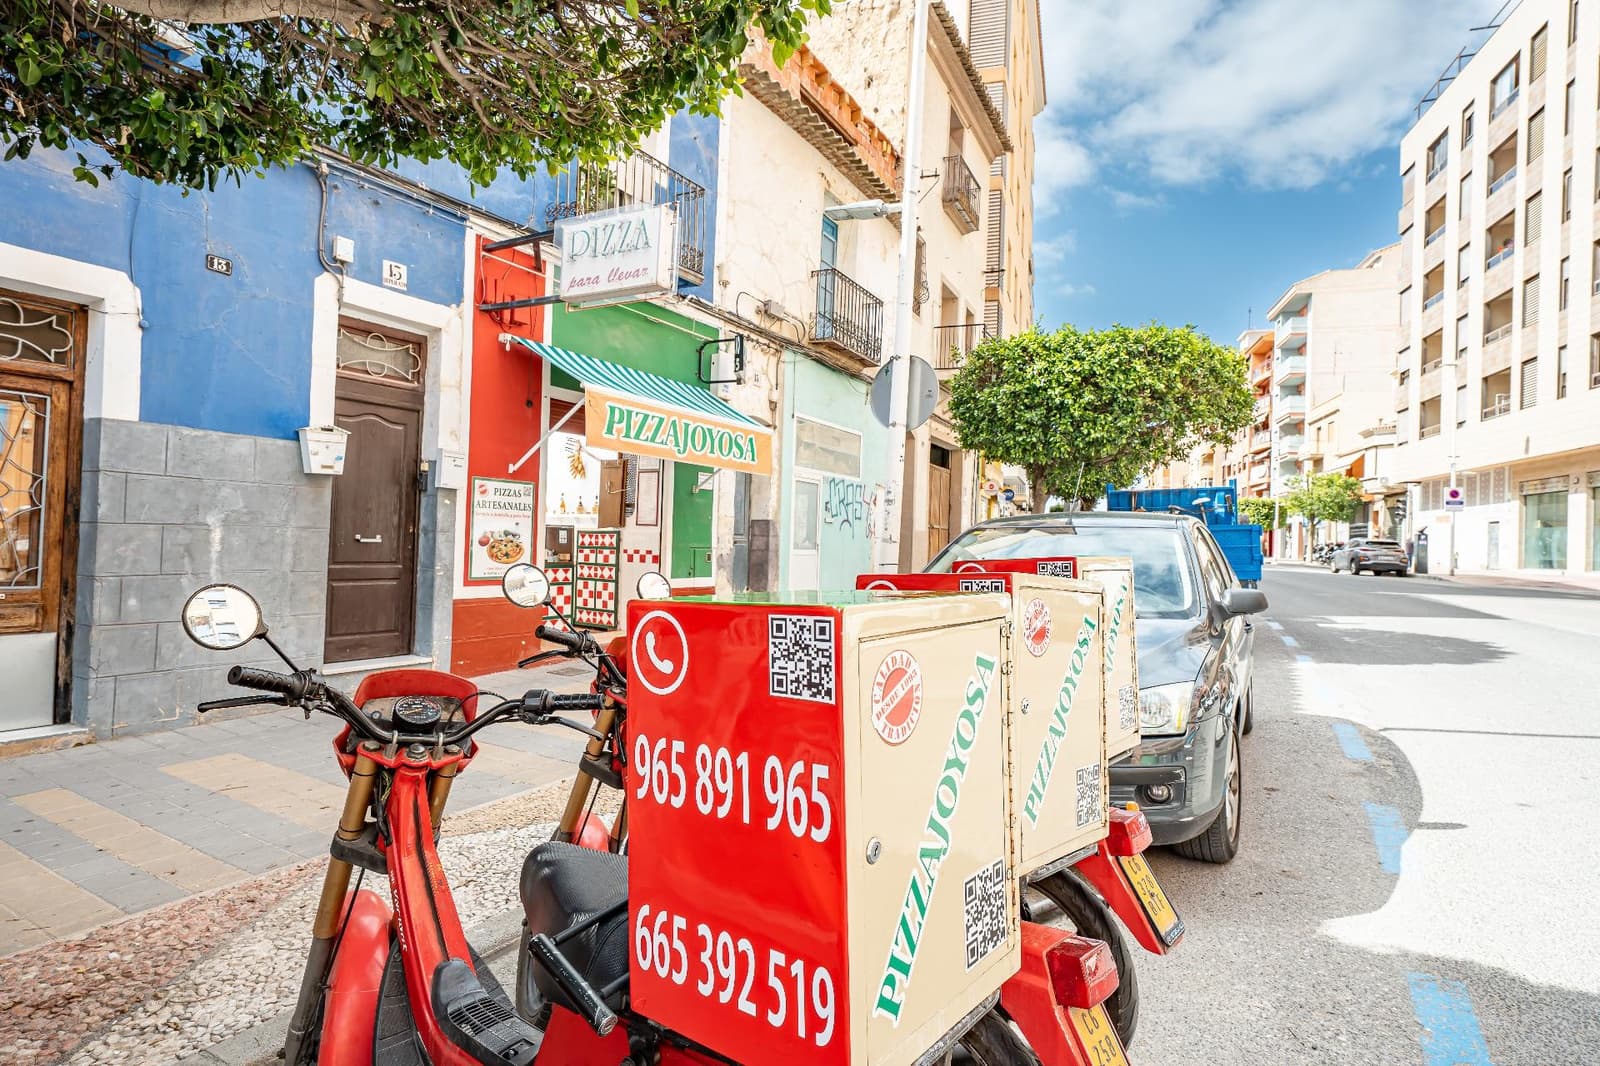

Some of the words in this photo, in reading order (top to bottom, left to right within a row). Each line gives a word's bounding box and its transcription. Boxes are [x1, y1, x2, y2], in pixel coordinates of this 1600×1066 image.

[212, 257, 226, 271] 13
[567, 275, 600, 292] para
[608, 266, 649, 284] llevar
[604, 404, 757, 462] PIZZAJOYOSA
[476, 499, 532, 512] ARTESANALES
[494, 487, 522, 498] PIZZAS
[873, 654, 912, 704] CALIDAD
[875, 688, 900, 721] DESDE
[1024, 616, 1097, 824] PIZZAJOYOSA
[634, 734, 687, 808] 965
[695, 743, 750, 825] 891
[763, 755, 832, 843] 965
[876, 655, 996, 1021] PIZZAJOYOSA
[635, 904, 688, 985] 665
[697, 923, 757, 1017] 392
[767, 948, 836, 1047] 519
